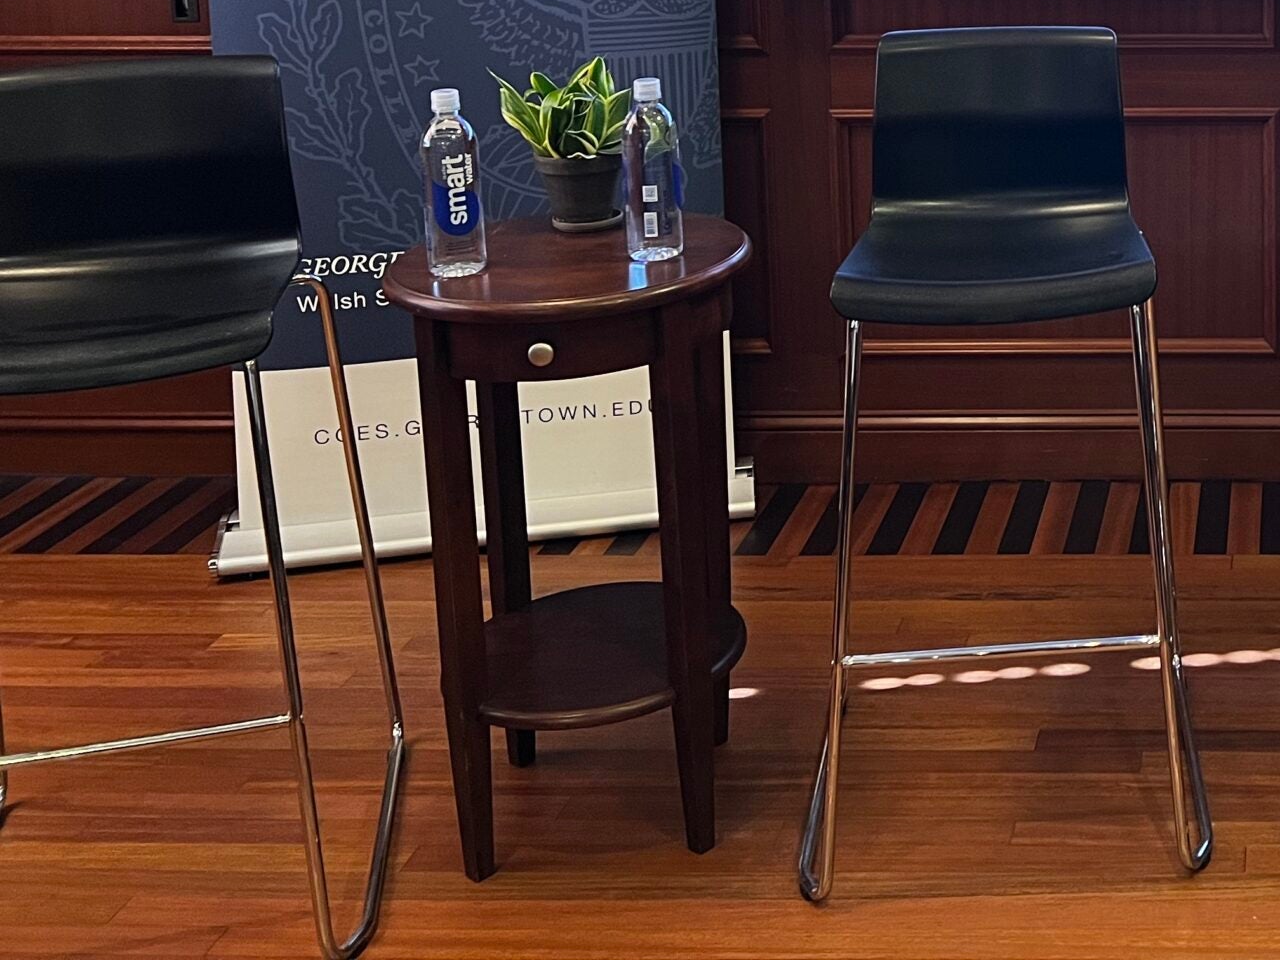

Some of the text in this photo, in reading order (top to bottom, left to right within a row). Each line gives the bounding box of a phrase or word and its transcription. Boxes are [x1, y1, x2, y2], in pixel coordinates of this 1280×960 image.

[464, 153, 474, 185] water
[441, 154, 468, 225] smart
[296, 291, 366, 313] Wlsh
